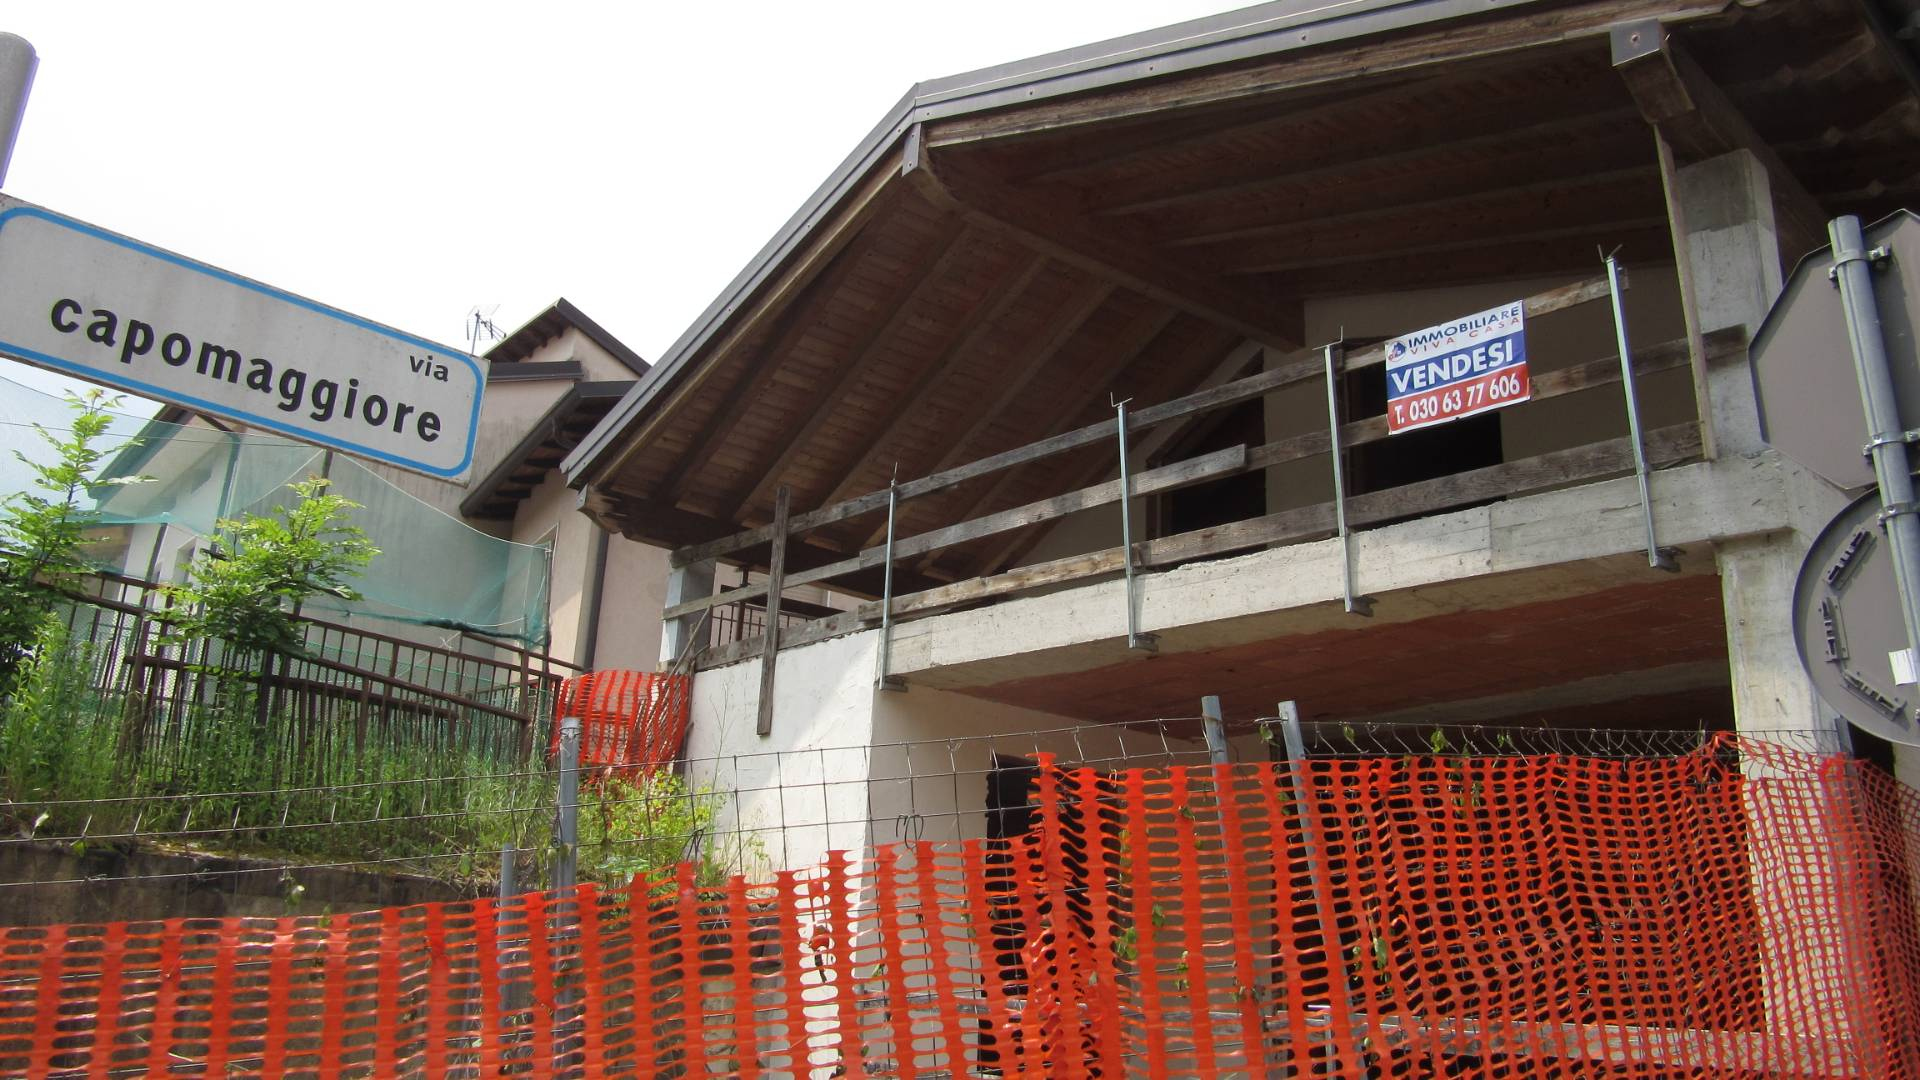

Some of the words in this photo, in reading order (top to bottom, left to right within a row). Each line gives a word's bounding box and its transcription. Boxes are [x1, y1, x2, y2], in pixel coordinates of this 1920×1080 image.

[1408, 305, 1519, 348] IMMOBILIARE
[1410, 337, 1455, 355] VIVA
[1468, 317, 1520, 338] CASA
[50, 297, 442, 442] capomaggiore
[409, 355, 448, 382] via
[1391, 339, 1513, 393] VENDESI
[1394, 404, 1405, 425] T.
[1409, 396, 1438, 421] 030
[1443, 390, 1462, 413] 63
[1467, 382, 1485, 407] 77
[1489, 373, 1520, 400] 606
